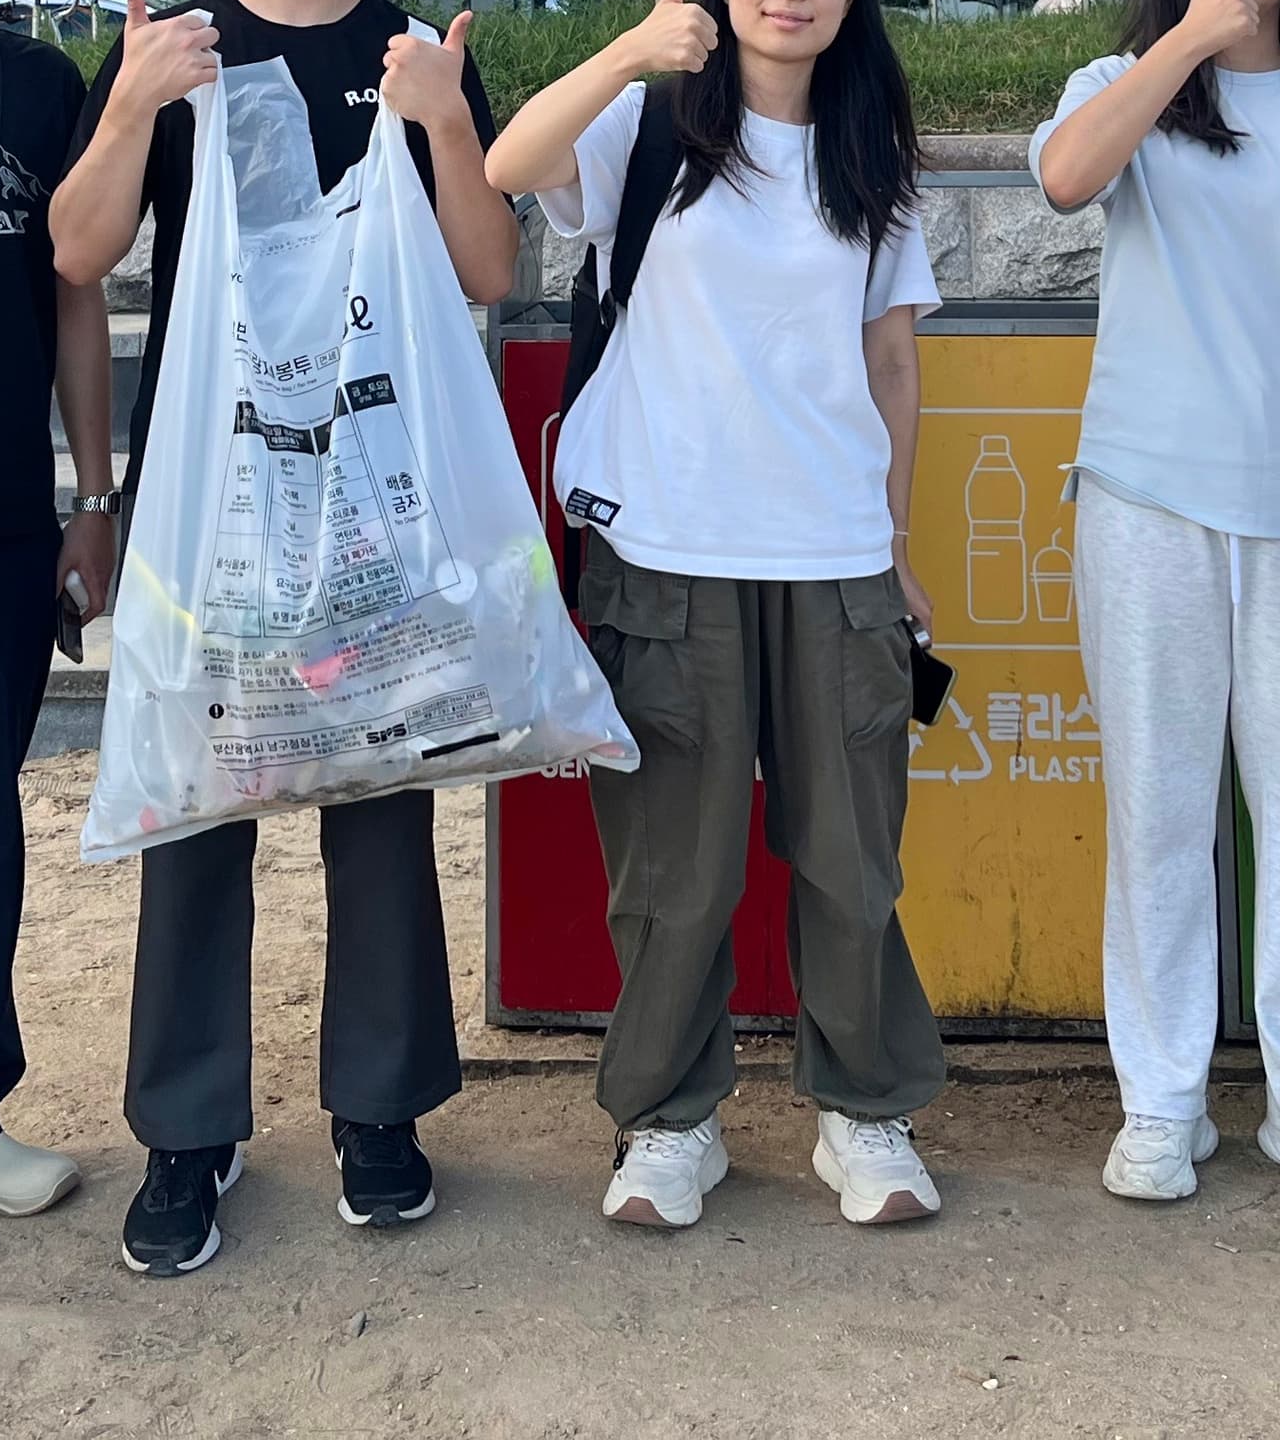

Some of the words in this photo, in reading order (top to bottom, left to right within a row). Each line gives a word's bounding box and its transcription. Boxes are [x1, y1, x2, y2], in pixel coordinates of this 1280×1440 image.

[386, 472, 415, 492] 배출
[392, 491, 422, 515] 금지
[212, 740, 265, 756] 부산광역시
